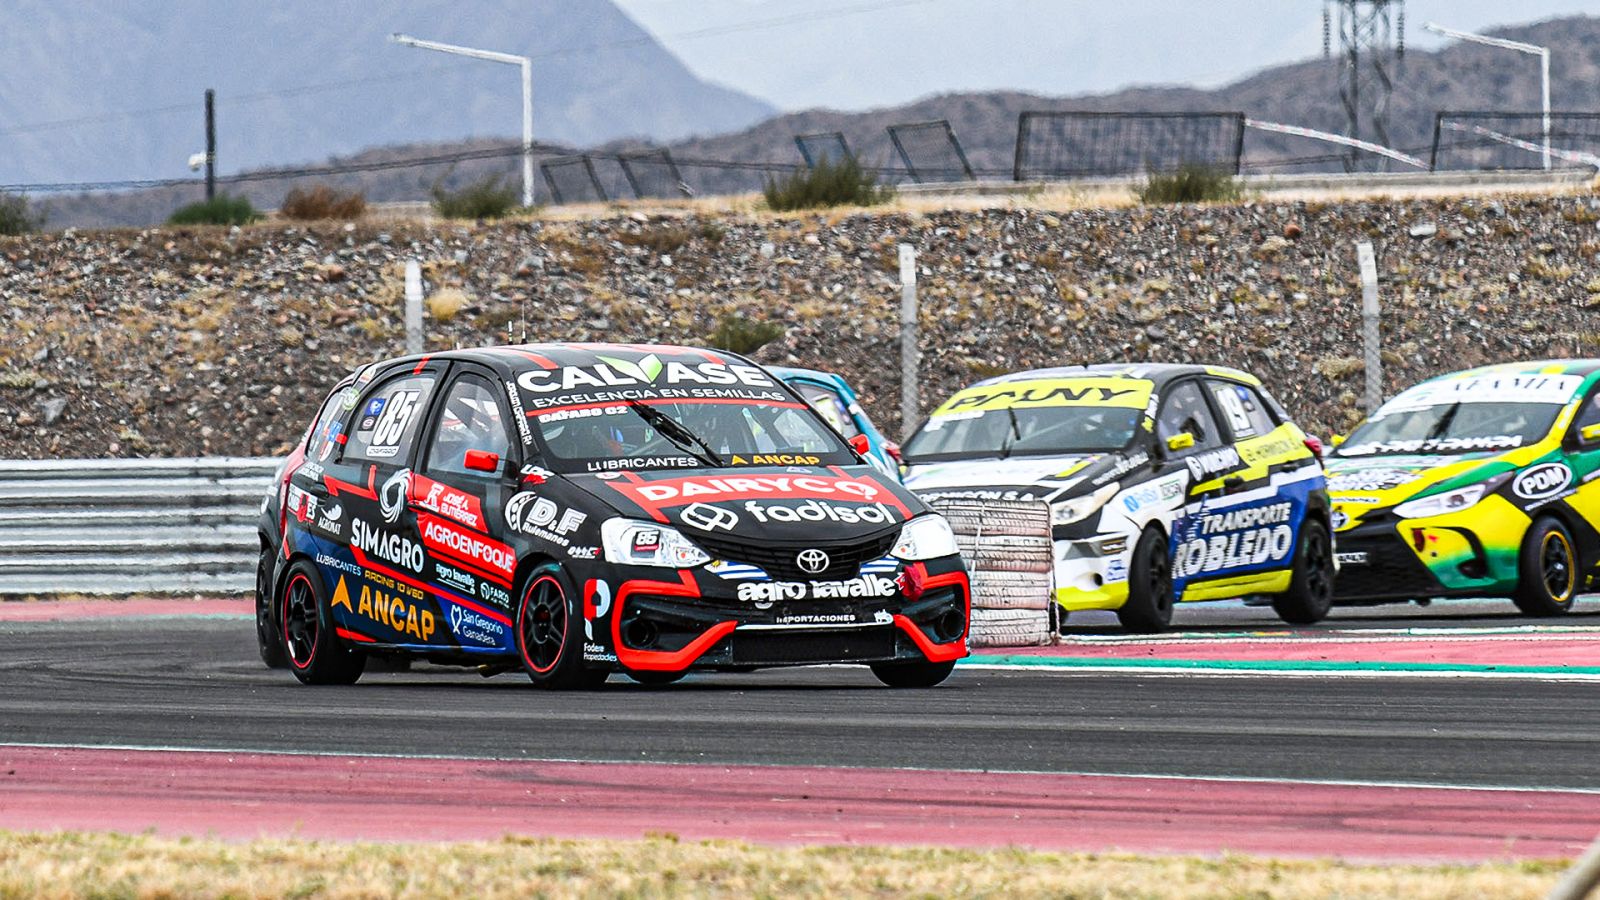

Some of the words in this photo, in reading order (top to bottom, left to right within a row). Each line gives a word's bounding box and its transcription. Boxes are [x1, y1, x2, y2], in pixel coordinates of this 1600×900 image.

[532, 388, 658, 408] EXCELENCIA
[662, 388, 687, 398] EN
[690, 387, 786, 401] SEMILLAS
[372, 390, 421, 446] 85
[587, 456, 699, 471] LUBRICANTES
[752, 455, 821, 466] ANCAP
[1522, 467, 1565, 494] PDM
[526, 496, 588, 536] D&F
[744, 499, 897, 524] fadisol
[1202, 502, 1292, 535] TRANSPORTE
[350, 517, 425, 573] SIMAGRO
[424, 521, 514, 573] AGROENFOQUE
[636, 532, 660, 545] 85
[315, 552, 362, 576] LUBRICANTES
[1170, 524, 1293, 580] ROBLEDO
[737, 580, 807, 609] agro
[811, 574, 896, 600] lavalle
[357, 584, 436, 642] ANCAP
[462, 609, 475, 625] San
[474, 614, 504, 635] Gregorio
[776, 614, 856, 624] IMPORTACIONES
[462, 625, 497, 647] Ganadera
